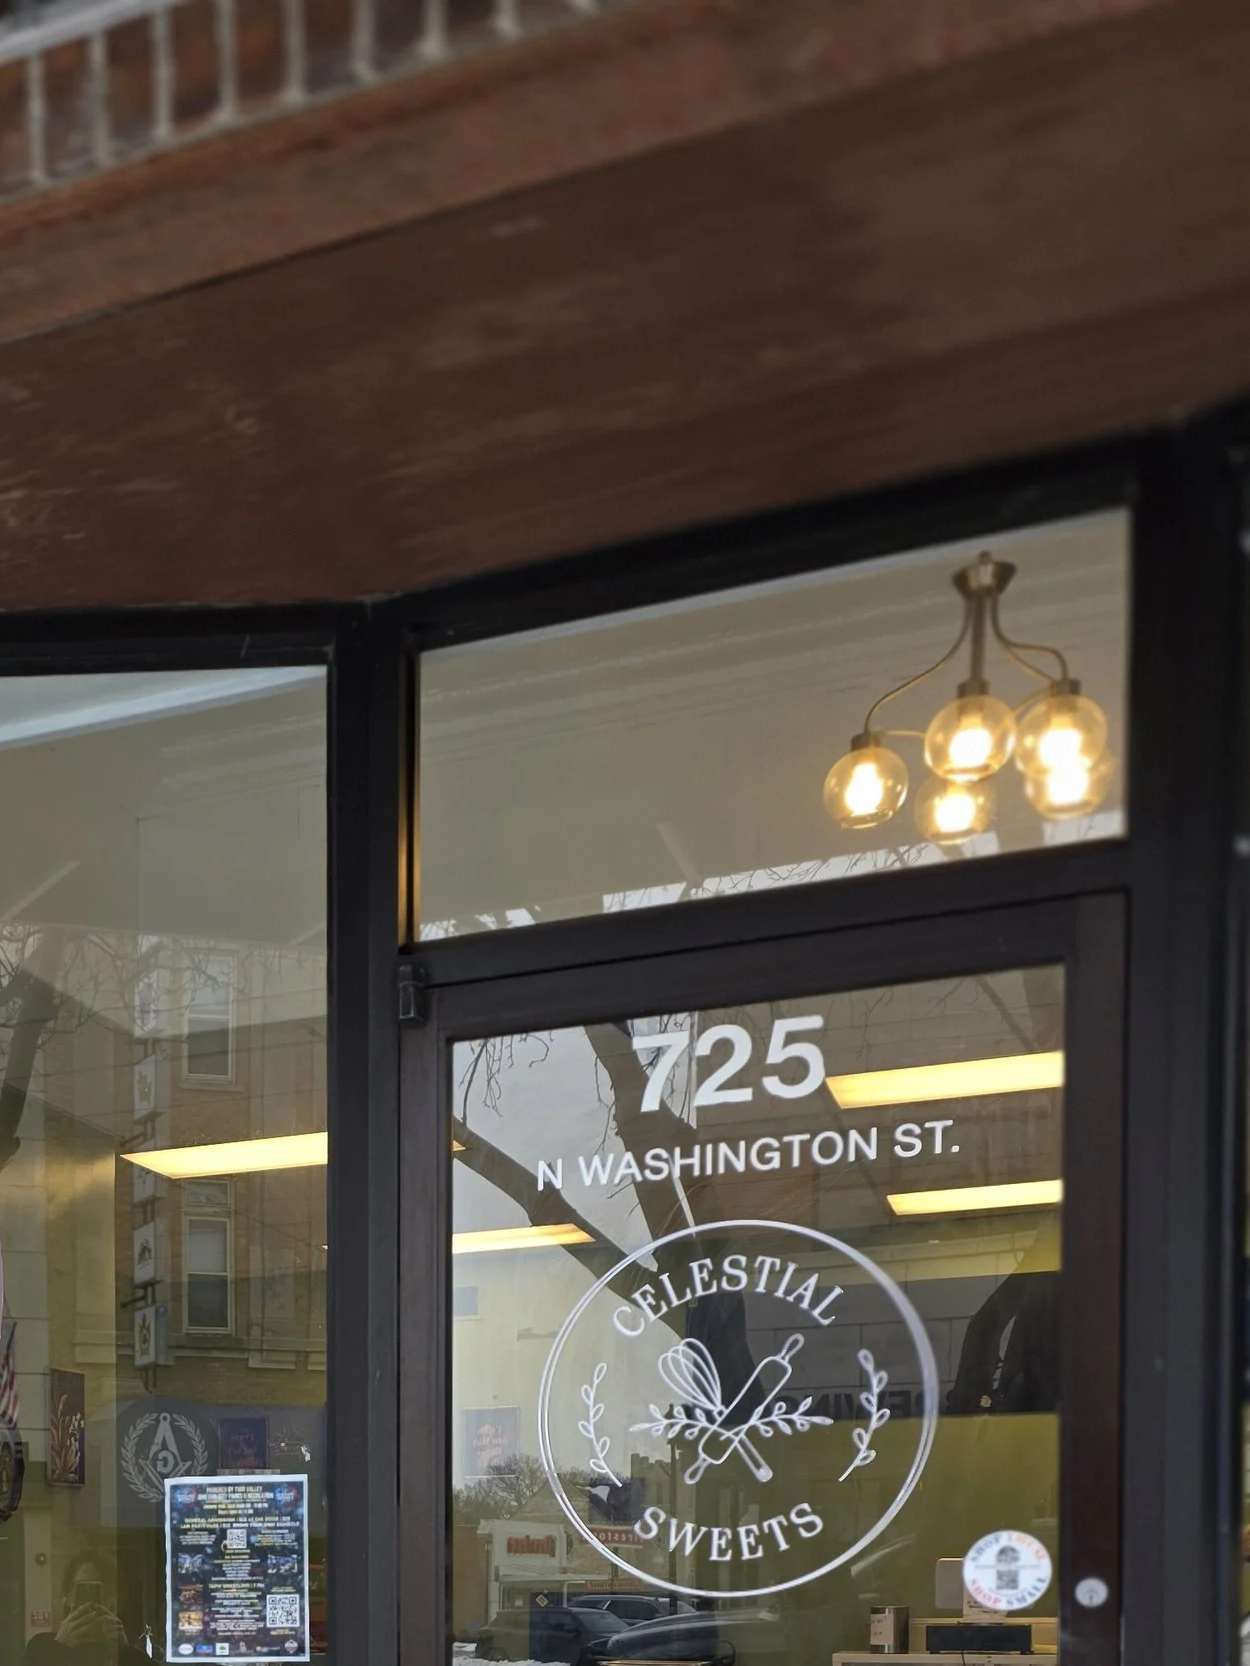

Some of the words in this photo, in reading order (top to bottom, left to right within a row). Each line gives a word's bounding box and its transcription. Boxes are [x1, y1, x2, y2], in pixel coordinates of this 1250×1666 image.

[631, 1015, 825, 1113] 725
[536, 1161, 563, 1192] N
[578, 1127, 877, 1187] WASHINGTON
[892, 1120, 960, 1159] ST.
[612, 1254, 843, 1338] CELESTIAL
[633, 1502, 825, 1561] SWEETS
